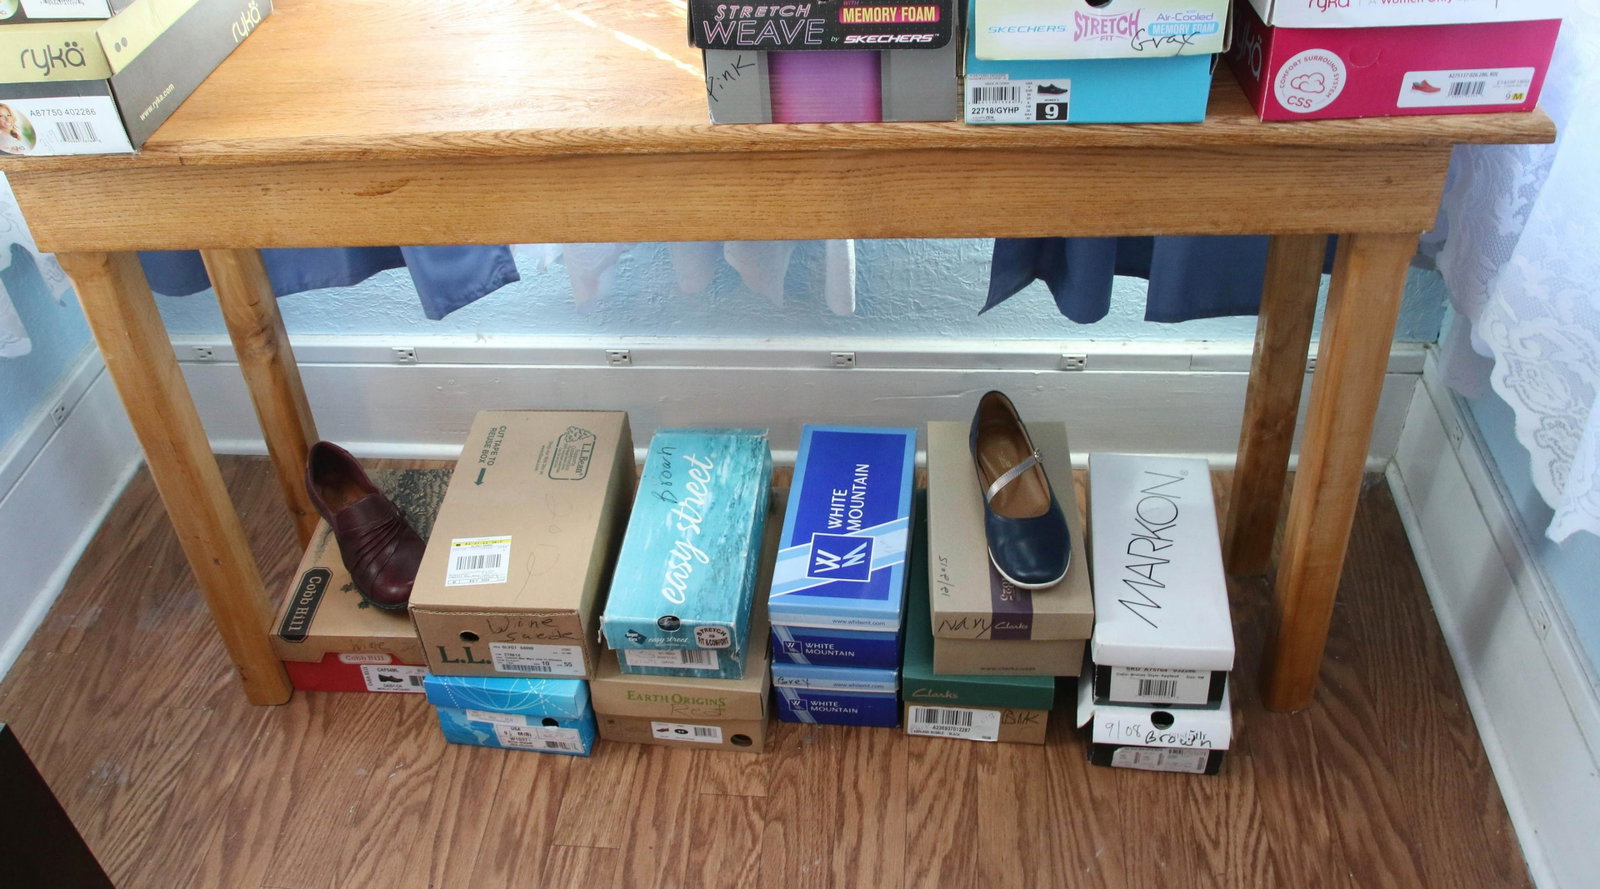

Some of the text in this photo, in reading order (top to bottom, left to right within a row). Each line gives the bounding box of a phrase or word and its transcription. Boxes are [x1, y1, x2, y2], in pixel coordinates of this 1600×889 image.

[714, 3, 811, 21] STRETCH
[843, 7, 936, 22] MEMORY FOAM
[1156, 12, 1214, 21] Air-Cooled
[703, 19, 825, 45] WEAVE
[988, 25, 1066, 33] SKECHERS
[1073, 8, 1141, 42] STRETCH
[1152, 23, 1215, 35] MEMORY FOAM
[844, 34, 935, 44] SKECHERS
[1280, 59, 1301, 89] COMFORT
[1304, 55, 1338, 72] SURROUND
[971, 106, 1020, 115] 22718/GYHP
[1287, 95, 1313, 109] CSS
[1044, 104, 1059, 119] 9
[478, 427, 497, 463] REUSE BOX
[487, 425, 507, 466] CUT TAPE TO
[671, 453, 715, 535] street
[846, 463, 870, 531] MOUNTAIN
[827, 488, 848, 529] WHITE
[1118, 470, 1185, 629] MARKON
[660, 539, 710, 605] easy
[1000, 577, 1015, 601] 825
[287, 576, 322, 632] Cobb Hill
[995, 622, 1028, 630] Clarks
[805, 648, 855, 657] MOUNTAIN
[912, 688, 958, 698] Clarks
[810, 700, 839, 708] WHITE
